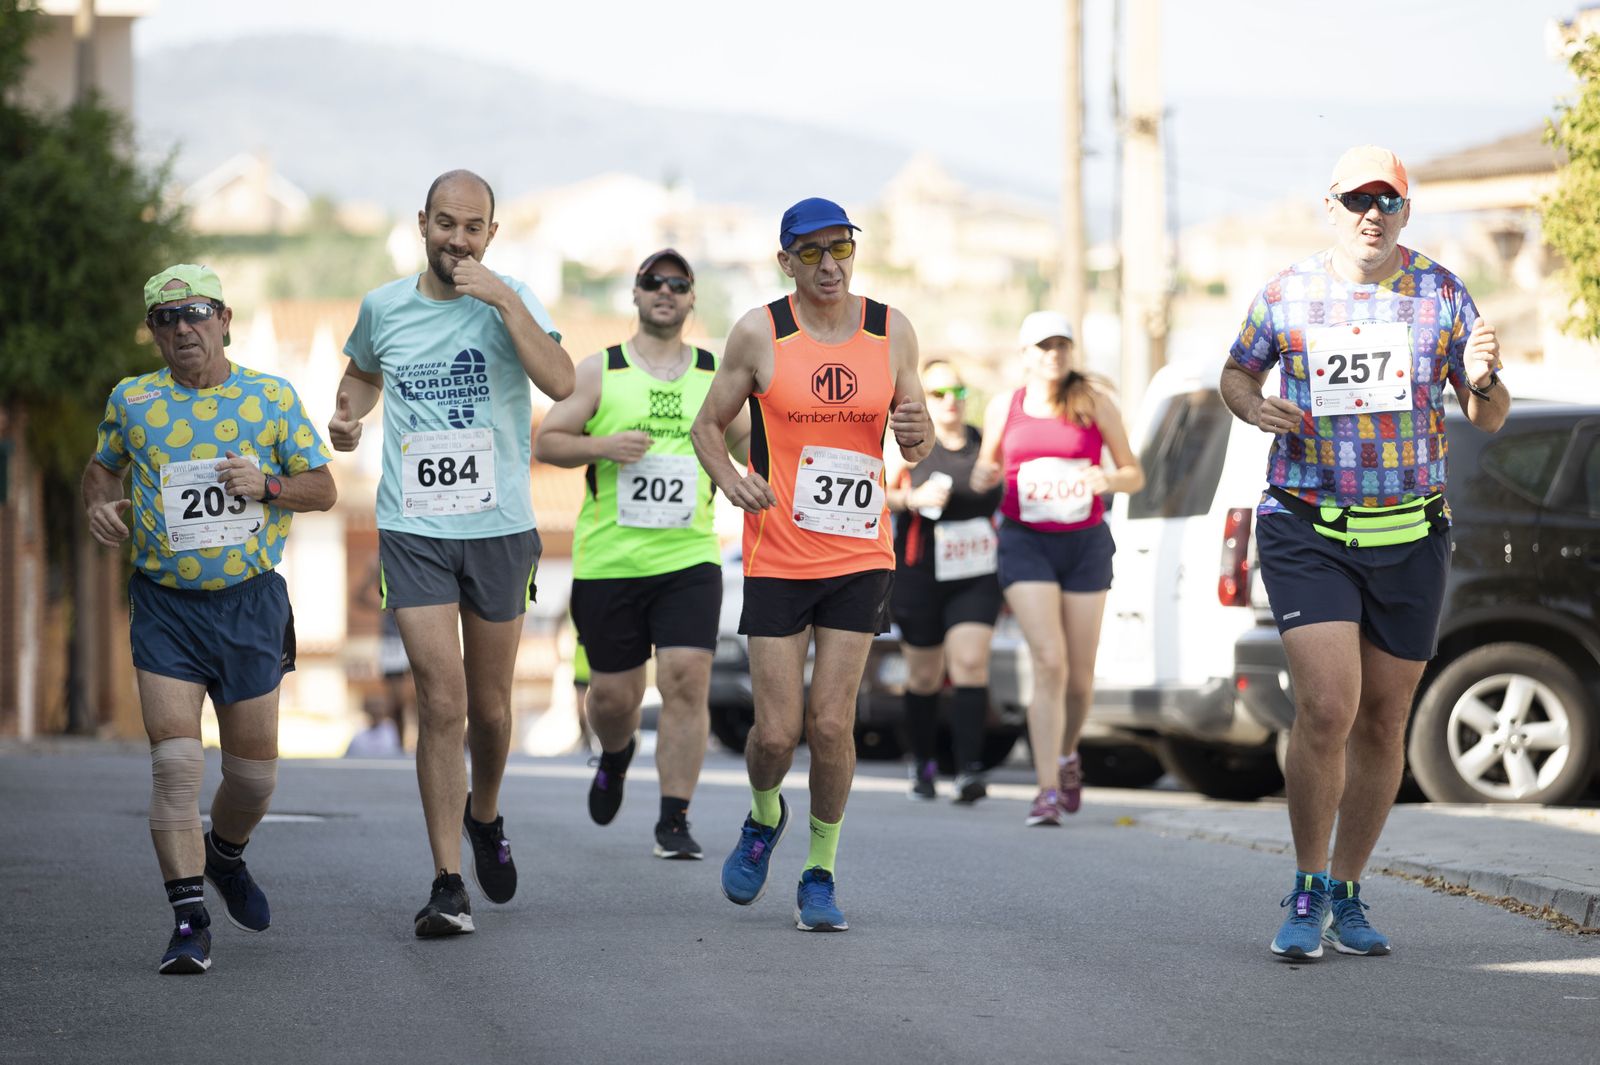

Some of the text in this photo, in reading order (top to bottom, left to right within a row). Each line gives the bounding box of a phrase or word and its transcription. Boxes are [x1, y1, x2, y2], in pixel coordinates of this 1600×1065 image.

[408, 369, 439, 377] FONDO
[413, 362, 447, 370] PRUEBA
[1328, 351, 1391, 385] 257
[403, 373, 488, 390] CORDERO
[816, 367, 853, 400] MG
[405, 384, 490, 401] SEGUREÑO
[787, 410, 879, 423] Kimber Motor
[626, 422, 691, 439] Alhambr
[418, 455, 479, 487] 684
[632, 477, 683, 503] 202
[813, 475, 873, 509] 370
[1027, 480, 1085, 500] 2200
[181, 486, 247, 520] 203
